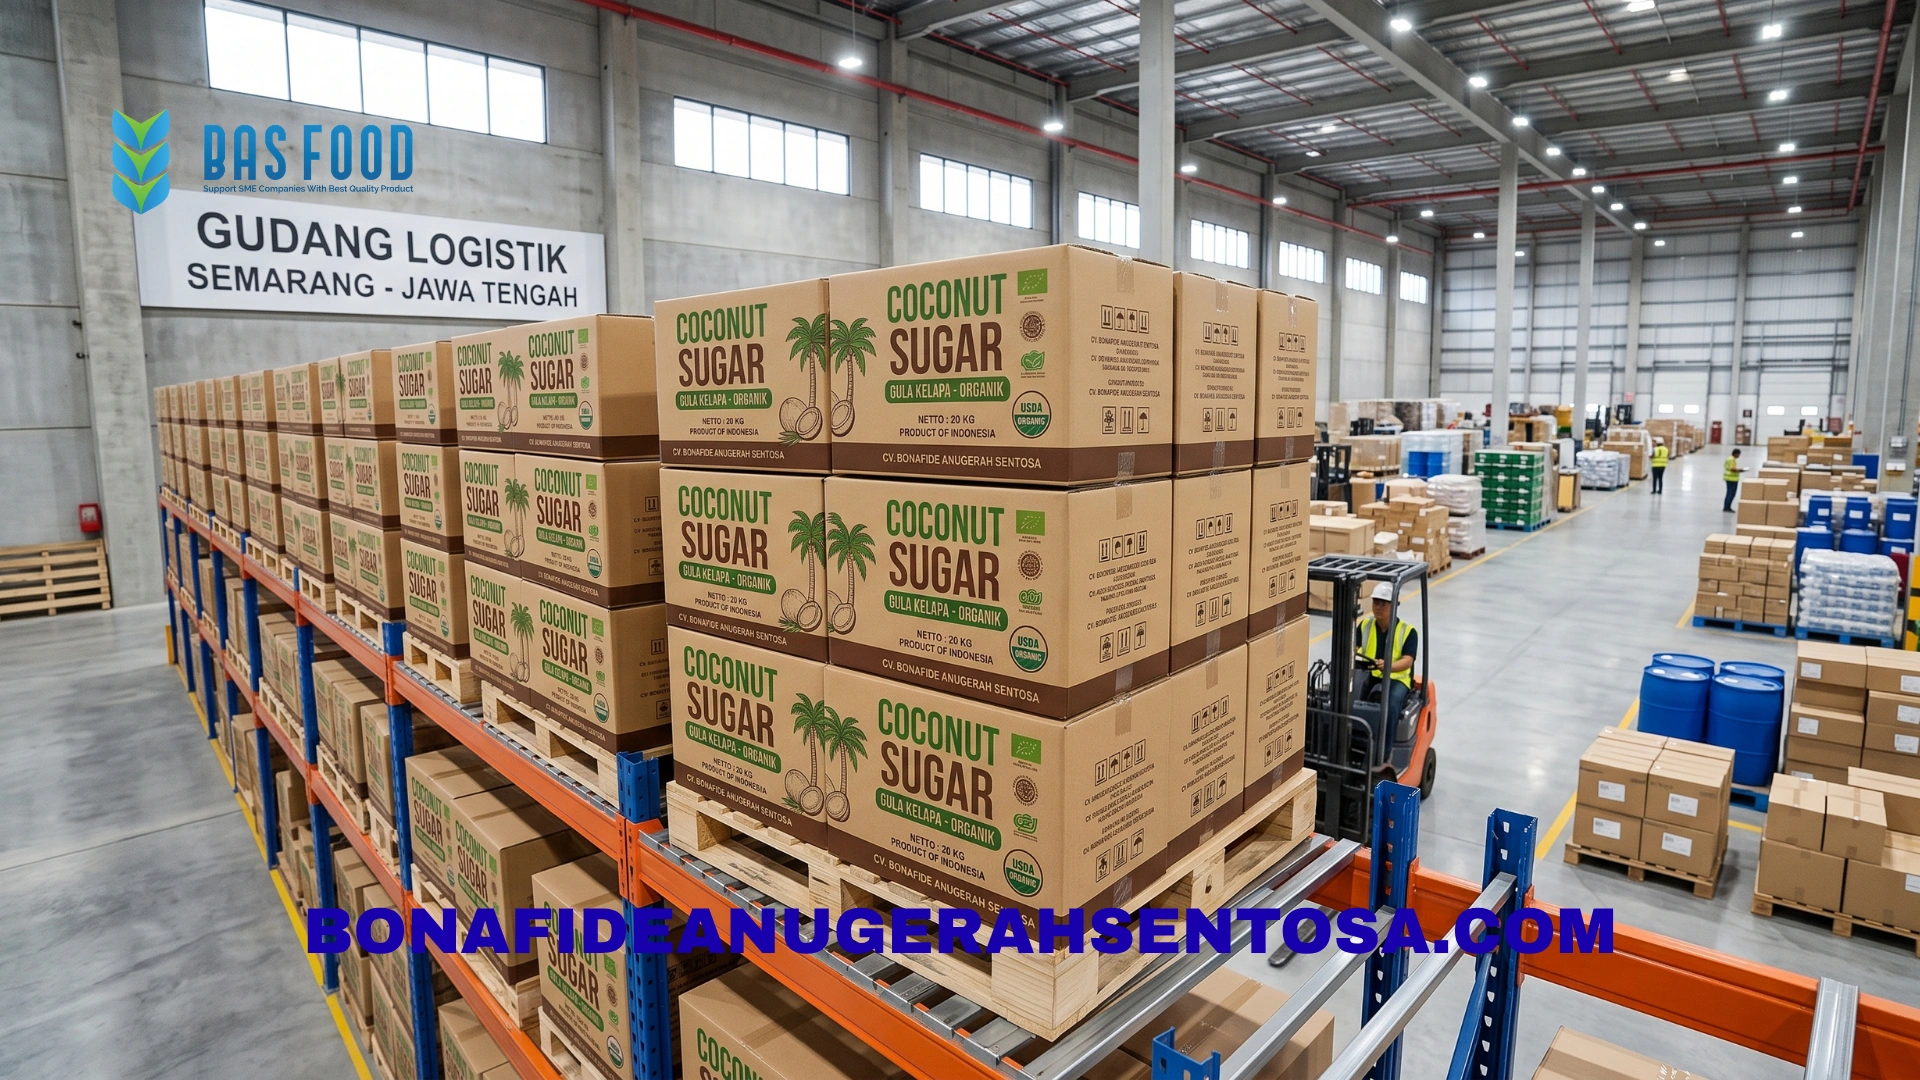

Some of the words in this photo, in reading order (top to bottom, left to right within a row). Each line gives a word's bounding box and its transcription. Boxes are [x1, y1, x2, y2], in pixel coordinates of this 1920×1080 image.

[197, 211, 393, 261] GUDANG
[406, 231, 568, 274] LOGISTIK
[187, 262, 374, 298] SEMARANG
[402, 277, 475, 302] JAWA
[482, 281, 578, 308] TENGAH
[887, 273, 1007, 323] COCONUT
[677, 303, 767, 345] COCONUT
[457, 342, 492, 367] COCONUT
[528, 330, 575, 359] COCONUT
[890, 322, 1002, 376] SUGAR
[459, 367, 492, 395] SUGAR
[530, 358, 574, 391] SUGAR
[678, 344, 765, 387] SUGAR
[399, 373, 425, 397] SUGAR
[680, 394, 698, 406] GULA
[700, 394, 727, 406] KELAPA
[733, 393, 767, 405] ORGANIK
[890, 384, 913, 399] GULA
[916, 383, 951, 398] KELAPA
[960, 381, 1004, 397] ORGANIK
[918, 415, 944, 424] NETTO
[951, 415, 960, 424] 20
[963, 415, 975, 424] KG
[1021, 403, 1042, 412] USDA
[900, 428, 936, 437] PRODUCT
[938, 429, 949, 437] OF
[951, 429, 996, 438] INDONESIA
[673, 448, 682, 456] CV.
[683, 448, 713, 457] BONAFIDE
[714, 449, 750, 458] ANUGERAH
[883, 453, 896, 463] CV.
[897, 454, 940, 464] BONAFIDE
[942, 455, 993, 466] ANUGERAH
[995, 456, 1041, 468] SENTOSA
[403, 472, 431, 499] SUGAR
[464, 461, 499, 487] COCONUT
[534, 467, 582, 498] COCONUT
[466, 486, 500, 518] SUGAR
[536, 494, 582, 533] SUGAR
[678, 485, 772, 525] COCONUT
[886, 499, 1004, 546] COCONUT
[681, 520, 769, 571] SUGAR
[406, 550, 436, 577] COCONUT
[683, 565, 701, 578] GULA
[702, 568, 730, 584] KELAPA
[737, 574, 771, 591] ORGANIK
[889, 541, 1000, 602] SUGAR
[408, 572, 438, 604] SUGAR
[470, 574, 506, 608] COCONUT
[695, 598, 720, 610] PRODUCT
[708, 591, 726, 601] NETTO
[473, 599, 507, 639] SUGAR
[539, 599, 588, 640] COCONUT
[889, 594, 912, 612] GULA
[914, 598, 949, 618] KELAPA
[959, 606, 1001, 626] ORGANIK
[720, 622, 755, 638] ANUGERAH
[756, 631, 787, 645] SENTOSA
[917, 630, 942, 641] NETTO
[949, 635, 958, 645] 20
[961, 638, 972, 647] KG
[1018, 636, 1039, 649] USDA
[542, 627, 589, 676] SUGAR
[900, 638, 935, 653] PRODUCT
[937, 646, 947, 655] OF
[949, 648, 993, 665] INDONESIA
[683, 645, 778, 702] COCONUT
[882, 659, 895, 670] CV.
[897, 662, 940, 680] BONAFIDE
[941, 671, 992, 692] ANUGERAH
[994, 683, 1040, 703] SENTOSA
[686, 681, 775, 748] SUGAR
[689, 725, 706, 741] GULA
[708, 731, 736, 754] KELAPA
[743, 746, 777, 769] ORGANIK
[878, 698, 1000, 767] COCONUT
[702, 762, 725, 777] PRODUCT
[713, 757, 731, 769] NETTO
[744, 769, 752, 778] KG
[880, 740, 994, 821] SUGAR
[411, 777, 442, 819] COCONUT
[414, 799, 444, 847] SUGAR
[761, 805, 792, 826] SENTOSA
[880, 793, 904, 813] GULA
[906, 801, 942, 827] KELAPA
[951, 818, 995, 846] ORGANIK
[455, 820, 487, 871] COCONUT
[891, 837, 927, 858] PRODUCT
[929, 851, 939, 862] OF
[941, 855, 985, 881] INDONESIA
[910, 833, 935, 850] NETTO
[942, 845, 951, 856] 20
[953, 849, 965, 861] KG
[457, 845, 488, 903] SUGAR
[1012, 858, 1034, 875] USDA
[873, 853, 887, 867] CV.
[889, 860, 932, 886] BONAFIDE
[935, 880, 985, 908] ANUGERAH
[988, 901, 1035, 929] SESA
[548, 932, 600, 1011] SUGAR
